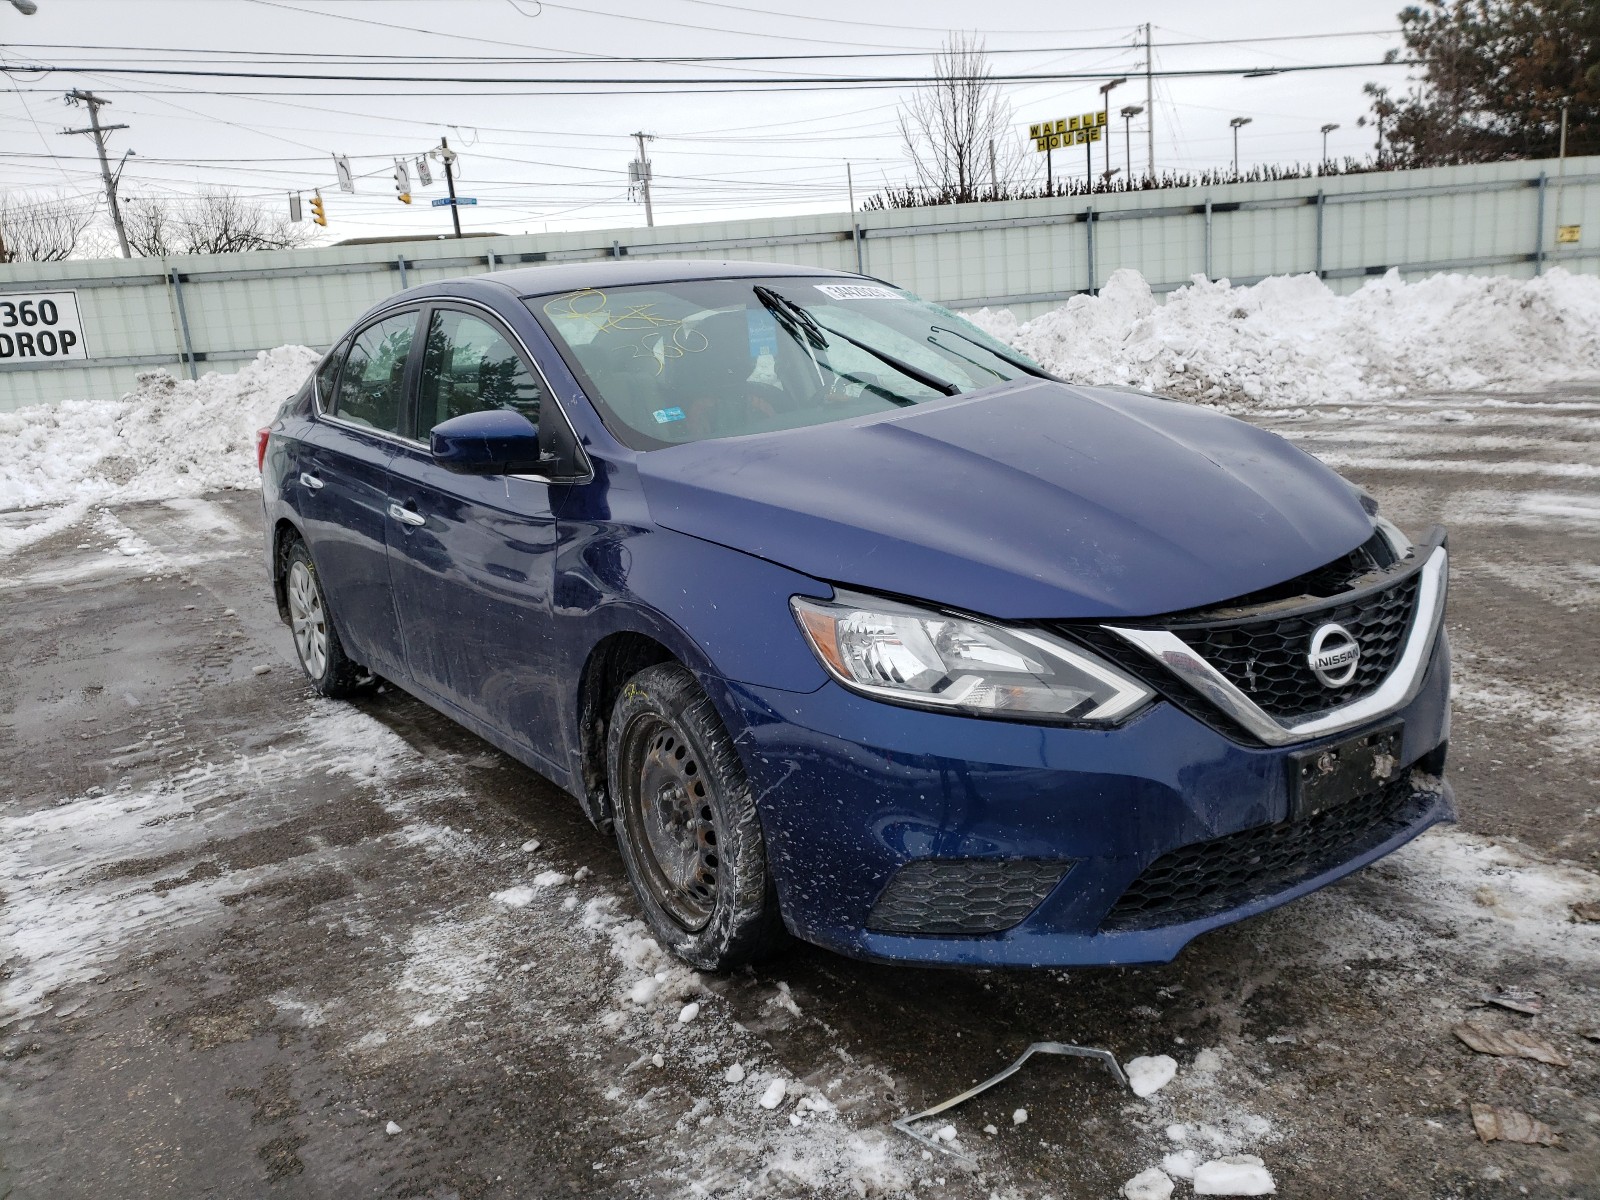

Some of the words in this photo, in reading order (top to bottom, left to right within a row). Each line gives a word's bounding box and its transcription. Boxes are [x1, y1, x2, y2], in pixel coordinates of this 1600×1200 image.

[1030, 112, 1105, 137] WAFFLE
[1037, 129, 1098, 151] HOUSE
[0, 299, 58, 327] 360
[0, 330, 76, 358] DROP
[1318, 648, 1359, 667] NISSAN
